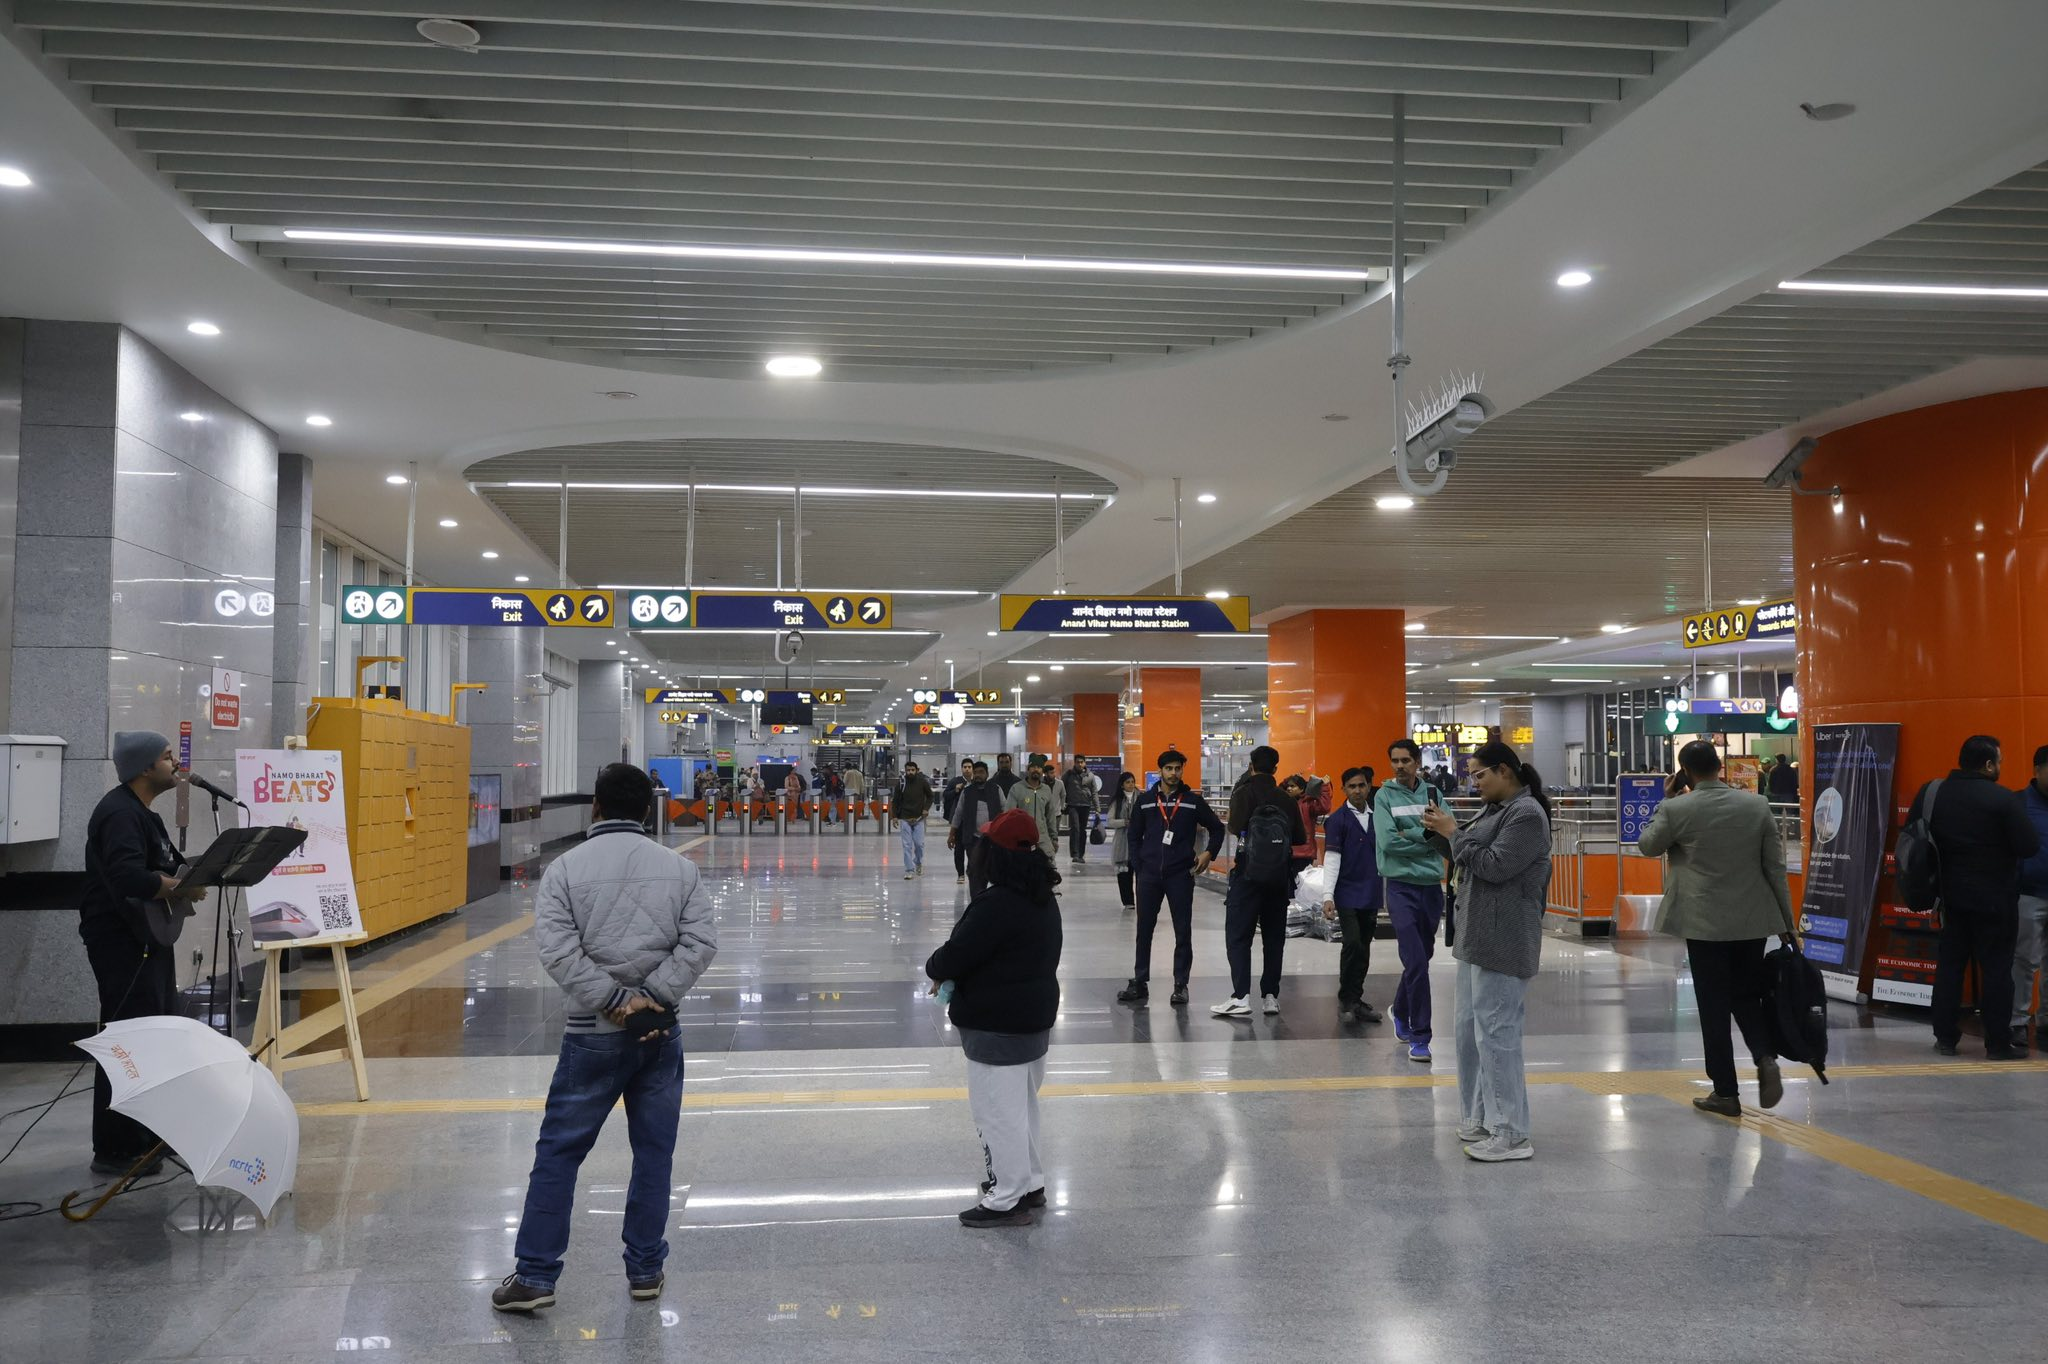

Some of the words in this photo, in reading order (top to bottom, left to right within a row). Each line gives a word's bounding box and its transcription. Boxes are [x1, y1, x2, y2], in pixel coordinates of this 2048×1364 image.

[491, 596, 523, 609] निकास
[773, 600, 804, 612] निकास
[503, 611, 522, 621] Exit
[1072, 606, 1094, 616] आनंद
[1095, 605, 1116, 617] विहार
[1117, 605, 1132, 616] नमो
[1133, 607, 1153, 616] भारत
[1154, 606, 1178, 616] स्टेशन
[785, 614, 804, 624] Exit
[1061, 619, 1086, 628] Anand
[1087, 619, 1109, 628] Vihar
[1110, 620, 1133, 628] Namo
[1134, 619, 1160, 628] Bharat
[1161, 619, 1189, 628] Station
[215, 697, 220, 706] Do
[1815, 732, 1831, 741] Uber
[254, 776, 331, 803] BEATS
[1891, 960, 1922, 969] ECONOMIC
[229, 1159, 253, 1174] ncrtc
